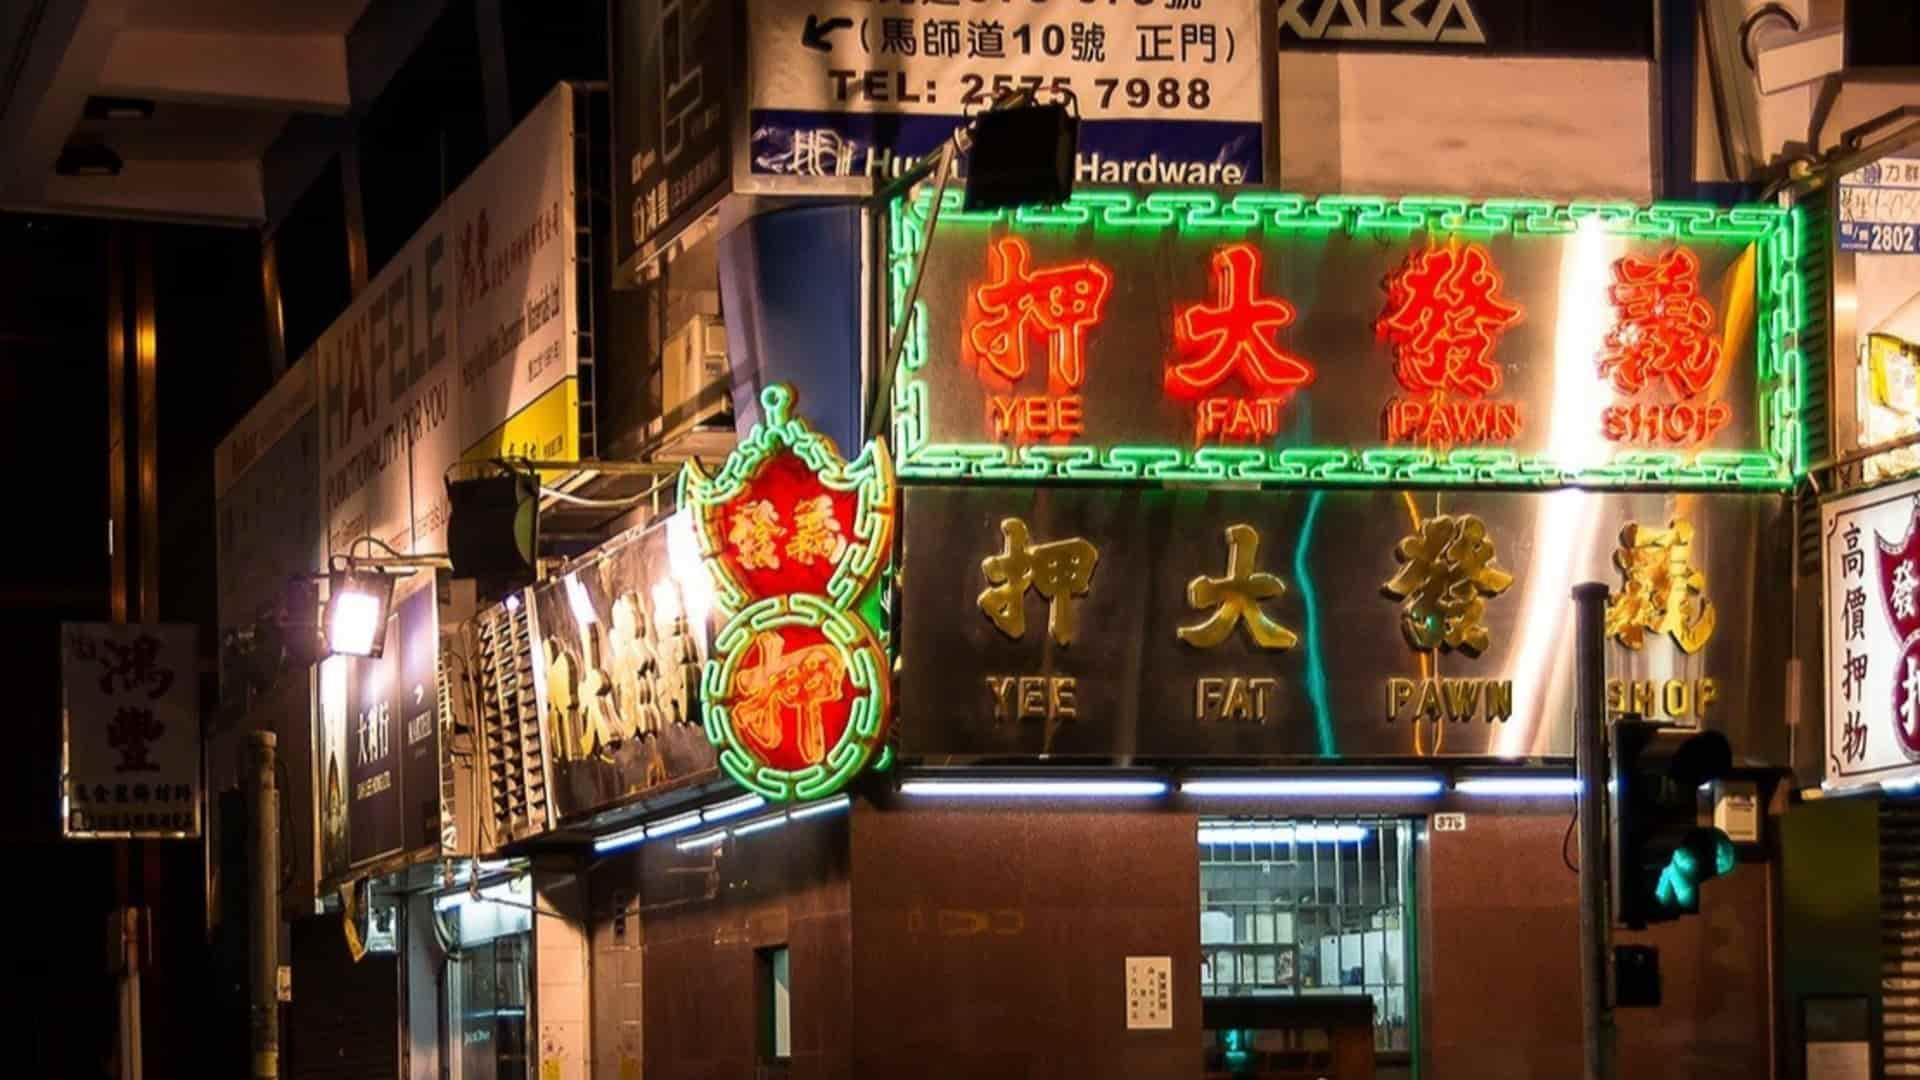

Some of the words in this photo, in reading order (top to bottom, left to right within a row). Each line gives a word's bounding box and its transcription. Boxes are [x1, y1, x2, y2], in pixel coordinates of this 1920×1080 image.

[828, 70, 937, 104] TEL:
[1094, 78, 1212, 109] 7988
[1075, 153, 1244, 184] Hardware
[1871, 224, 1914, 251] 2802
[423, 378, 449, 433] YOU
[989, 396, 1084, 433] YEE
[1199, 396, 1284, 434] FAT
[1386, 401, 1526, 442] PAWN
[1601, 401, 1732, 442] SHOP
[1840, 521, 1869, 766] 高價押物
[985, 676, 1079, 720] YEE
[1195, 676, 1279, 723] FAT
[1386, 676, 1513, 723] PAWN
[1606, 678, 1719, 719] SHOP
